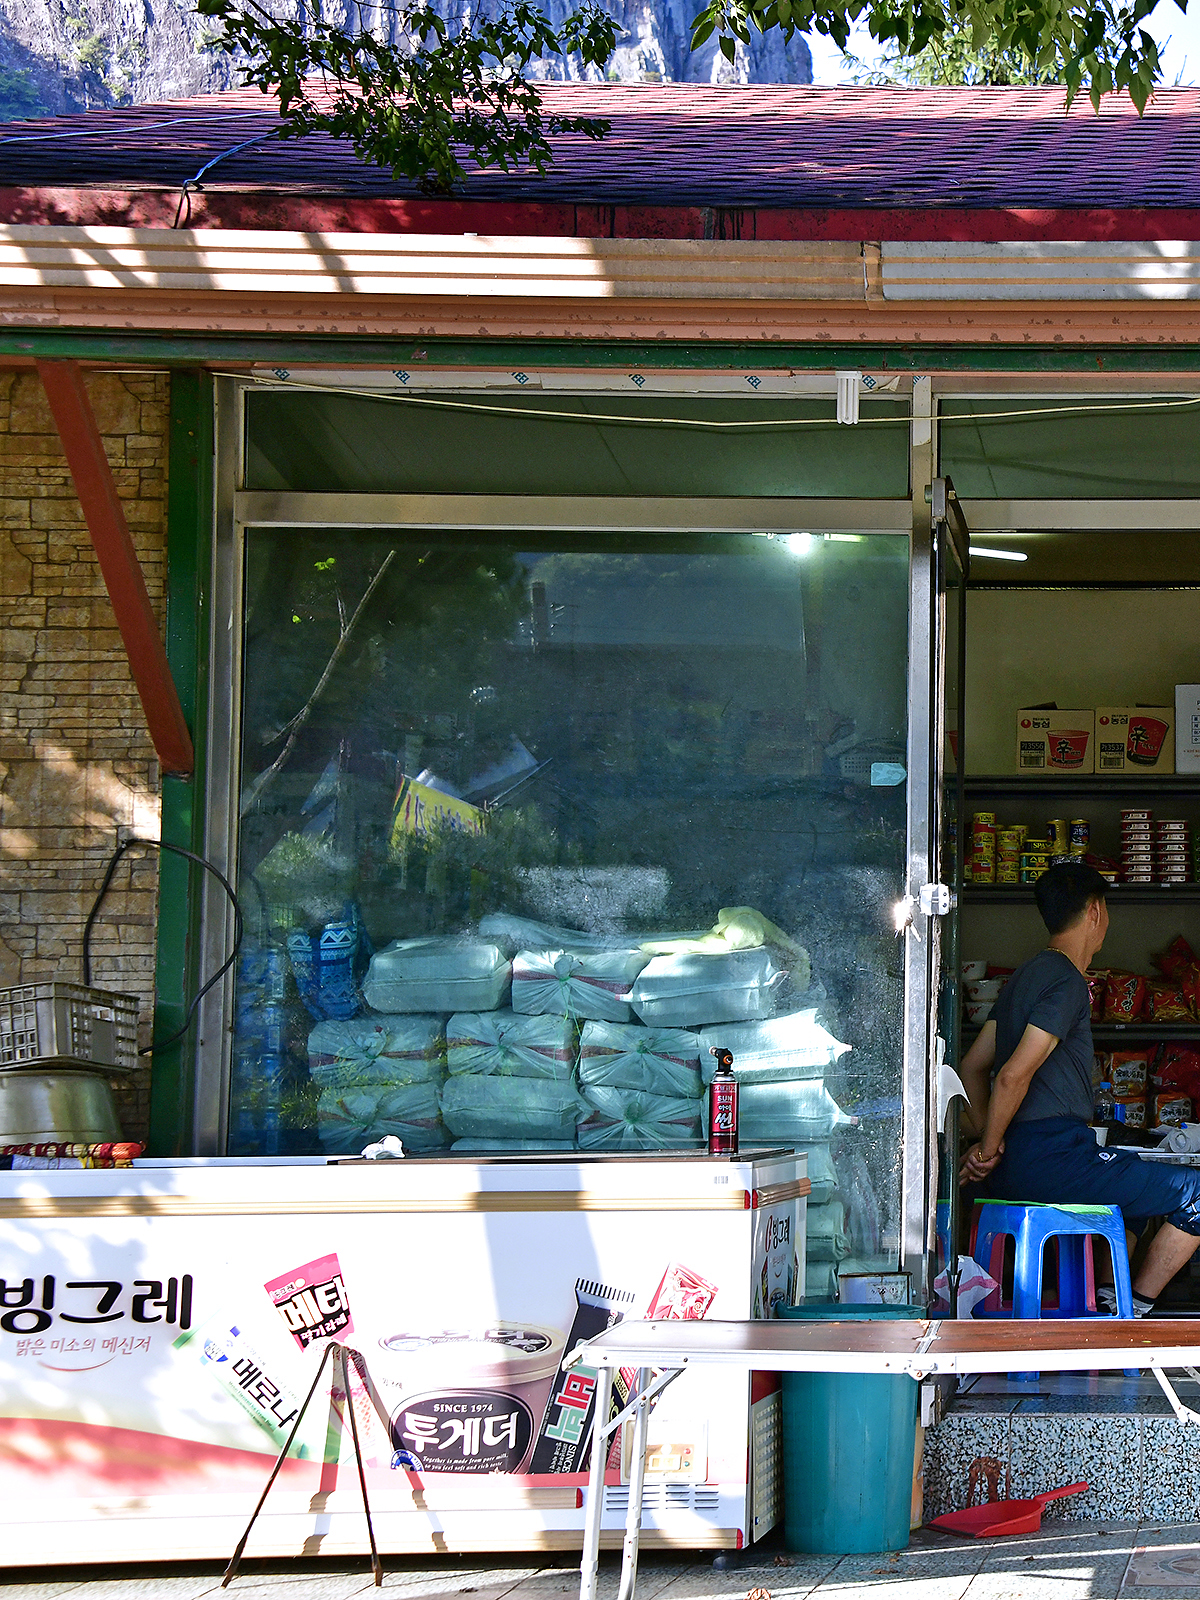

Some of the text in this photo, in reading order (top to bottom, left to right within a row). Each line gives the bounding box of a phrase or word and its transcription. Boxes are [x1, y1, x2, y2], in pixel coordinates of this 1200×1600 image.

[1032, 720, 1050, 729] 농심
[1111, 717, 1128, 725] 농심
[1121, 978, 1138, 1012] 새우깡
[0, 1274, 194, 1334] 빙그레
[16, 1336, 152, 1357] 밝은 미소의 메신저
[232, 1358, 299, 1428] 메로나
[433, 1403, 493, 1413] SINCE 1974
[402, 1411, 520, 1456] 투게더
[422, 1455, 446, 1465] Together
[468, 1456, 483, 1464] from
[441, 1462, 453, 1471] feel
